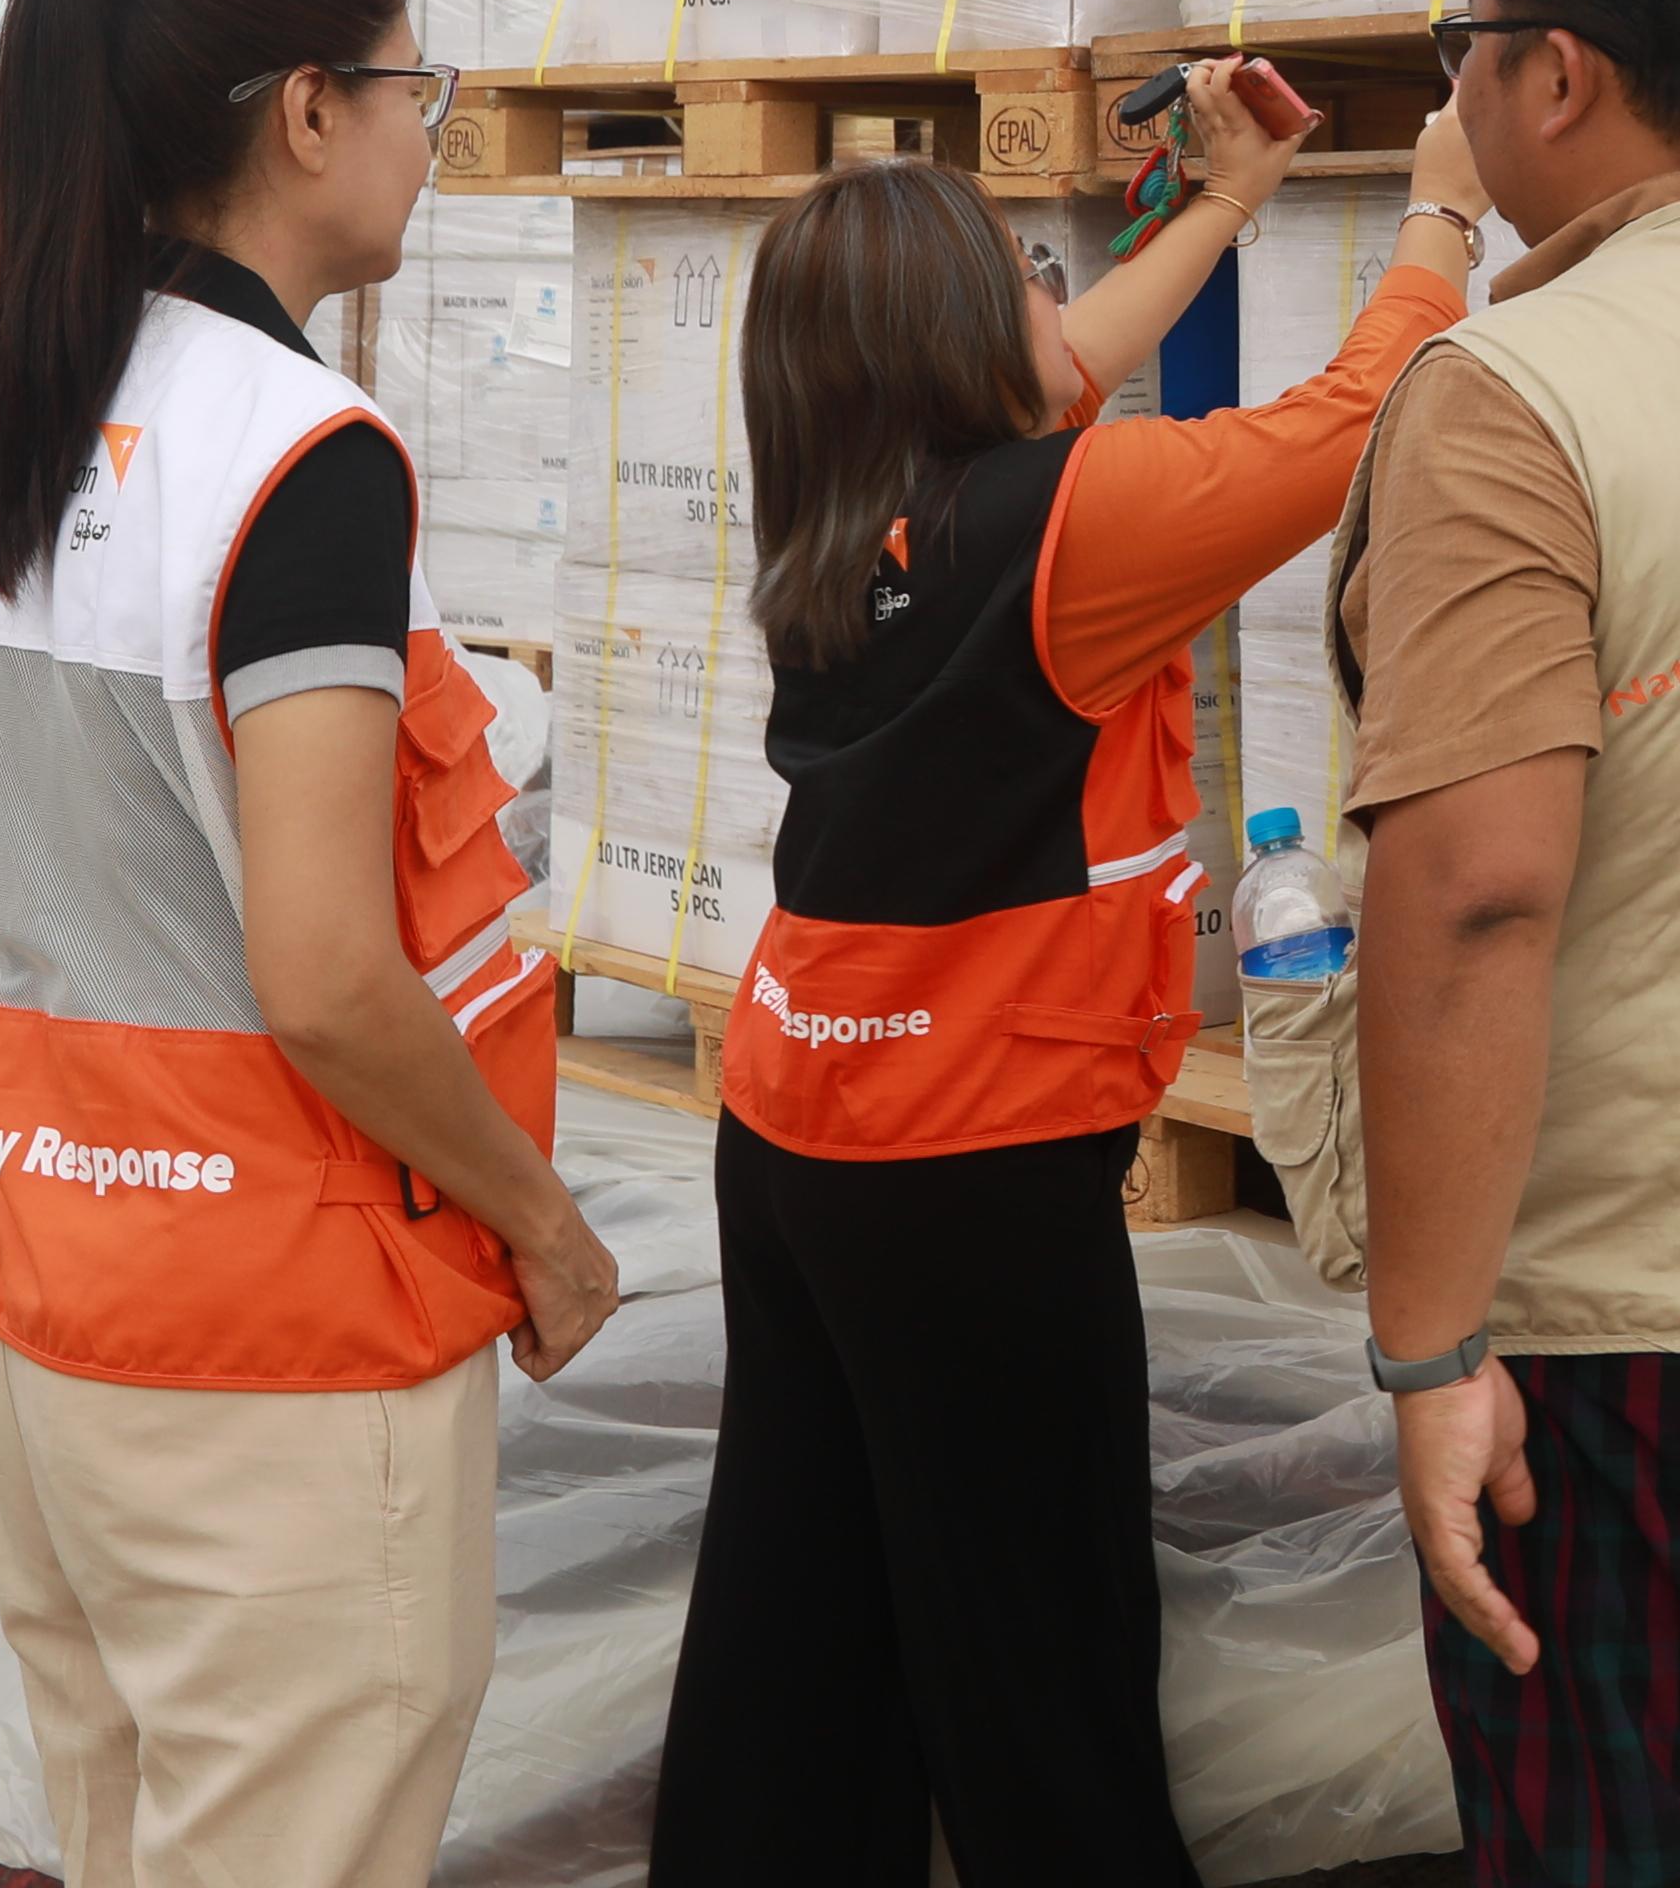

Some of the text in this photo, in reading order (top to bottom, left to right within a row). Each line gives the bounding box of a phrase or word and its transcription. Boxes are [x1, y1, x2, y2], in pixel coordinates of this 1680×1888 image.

[447, 130, 479, 159] EPAL
[996, 118, 1043, 155] EPAL
[442, 296, 508, 310] MADE IN CHINA
[542, 457, 568, 470] MADE
[597, 839, 612, 864] 10
[615, 843, 638, 869] LTR
[641, 849, 684, 881] JERRY
[1193, 909, 1223, 938] 10
[21, 1125, 235, 1197] Response
